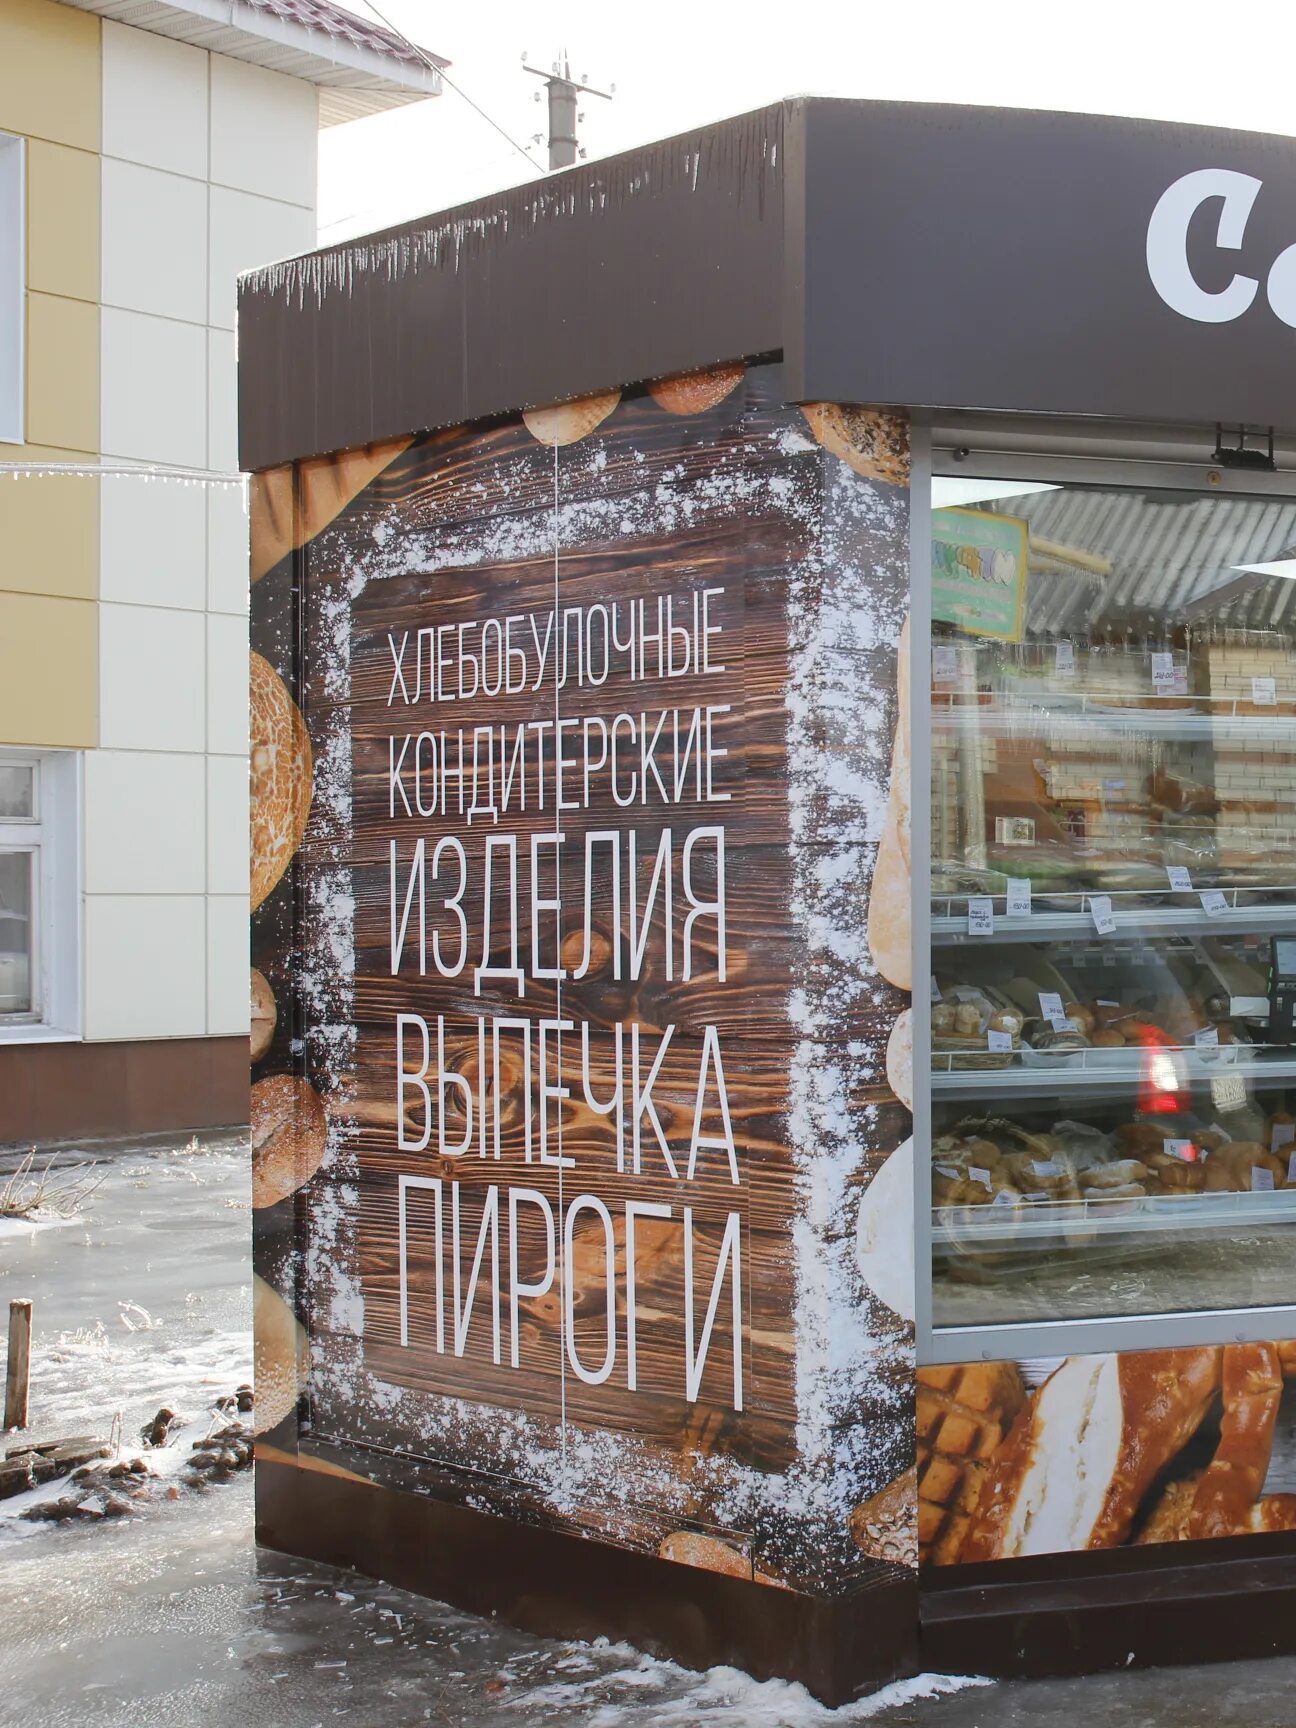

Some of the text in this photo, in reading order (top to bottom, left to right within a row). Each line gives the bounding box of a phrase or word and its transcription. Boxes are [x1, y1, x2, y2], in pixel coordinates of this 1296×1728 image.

[387, 586, 726, 707] ХЛЕБОБУЛОЧНЫЕ
[389, 704, 732, 826] КОНДИТЕРСКИЕ
[389, 825, 727, 998] ИЗДЕЛИЯ
[396, 1013, 741, 1185] ВЫПЕЧКА
[398, 1174, 743, 1412] ПИРОГИ
